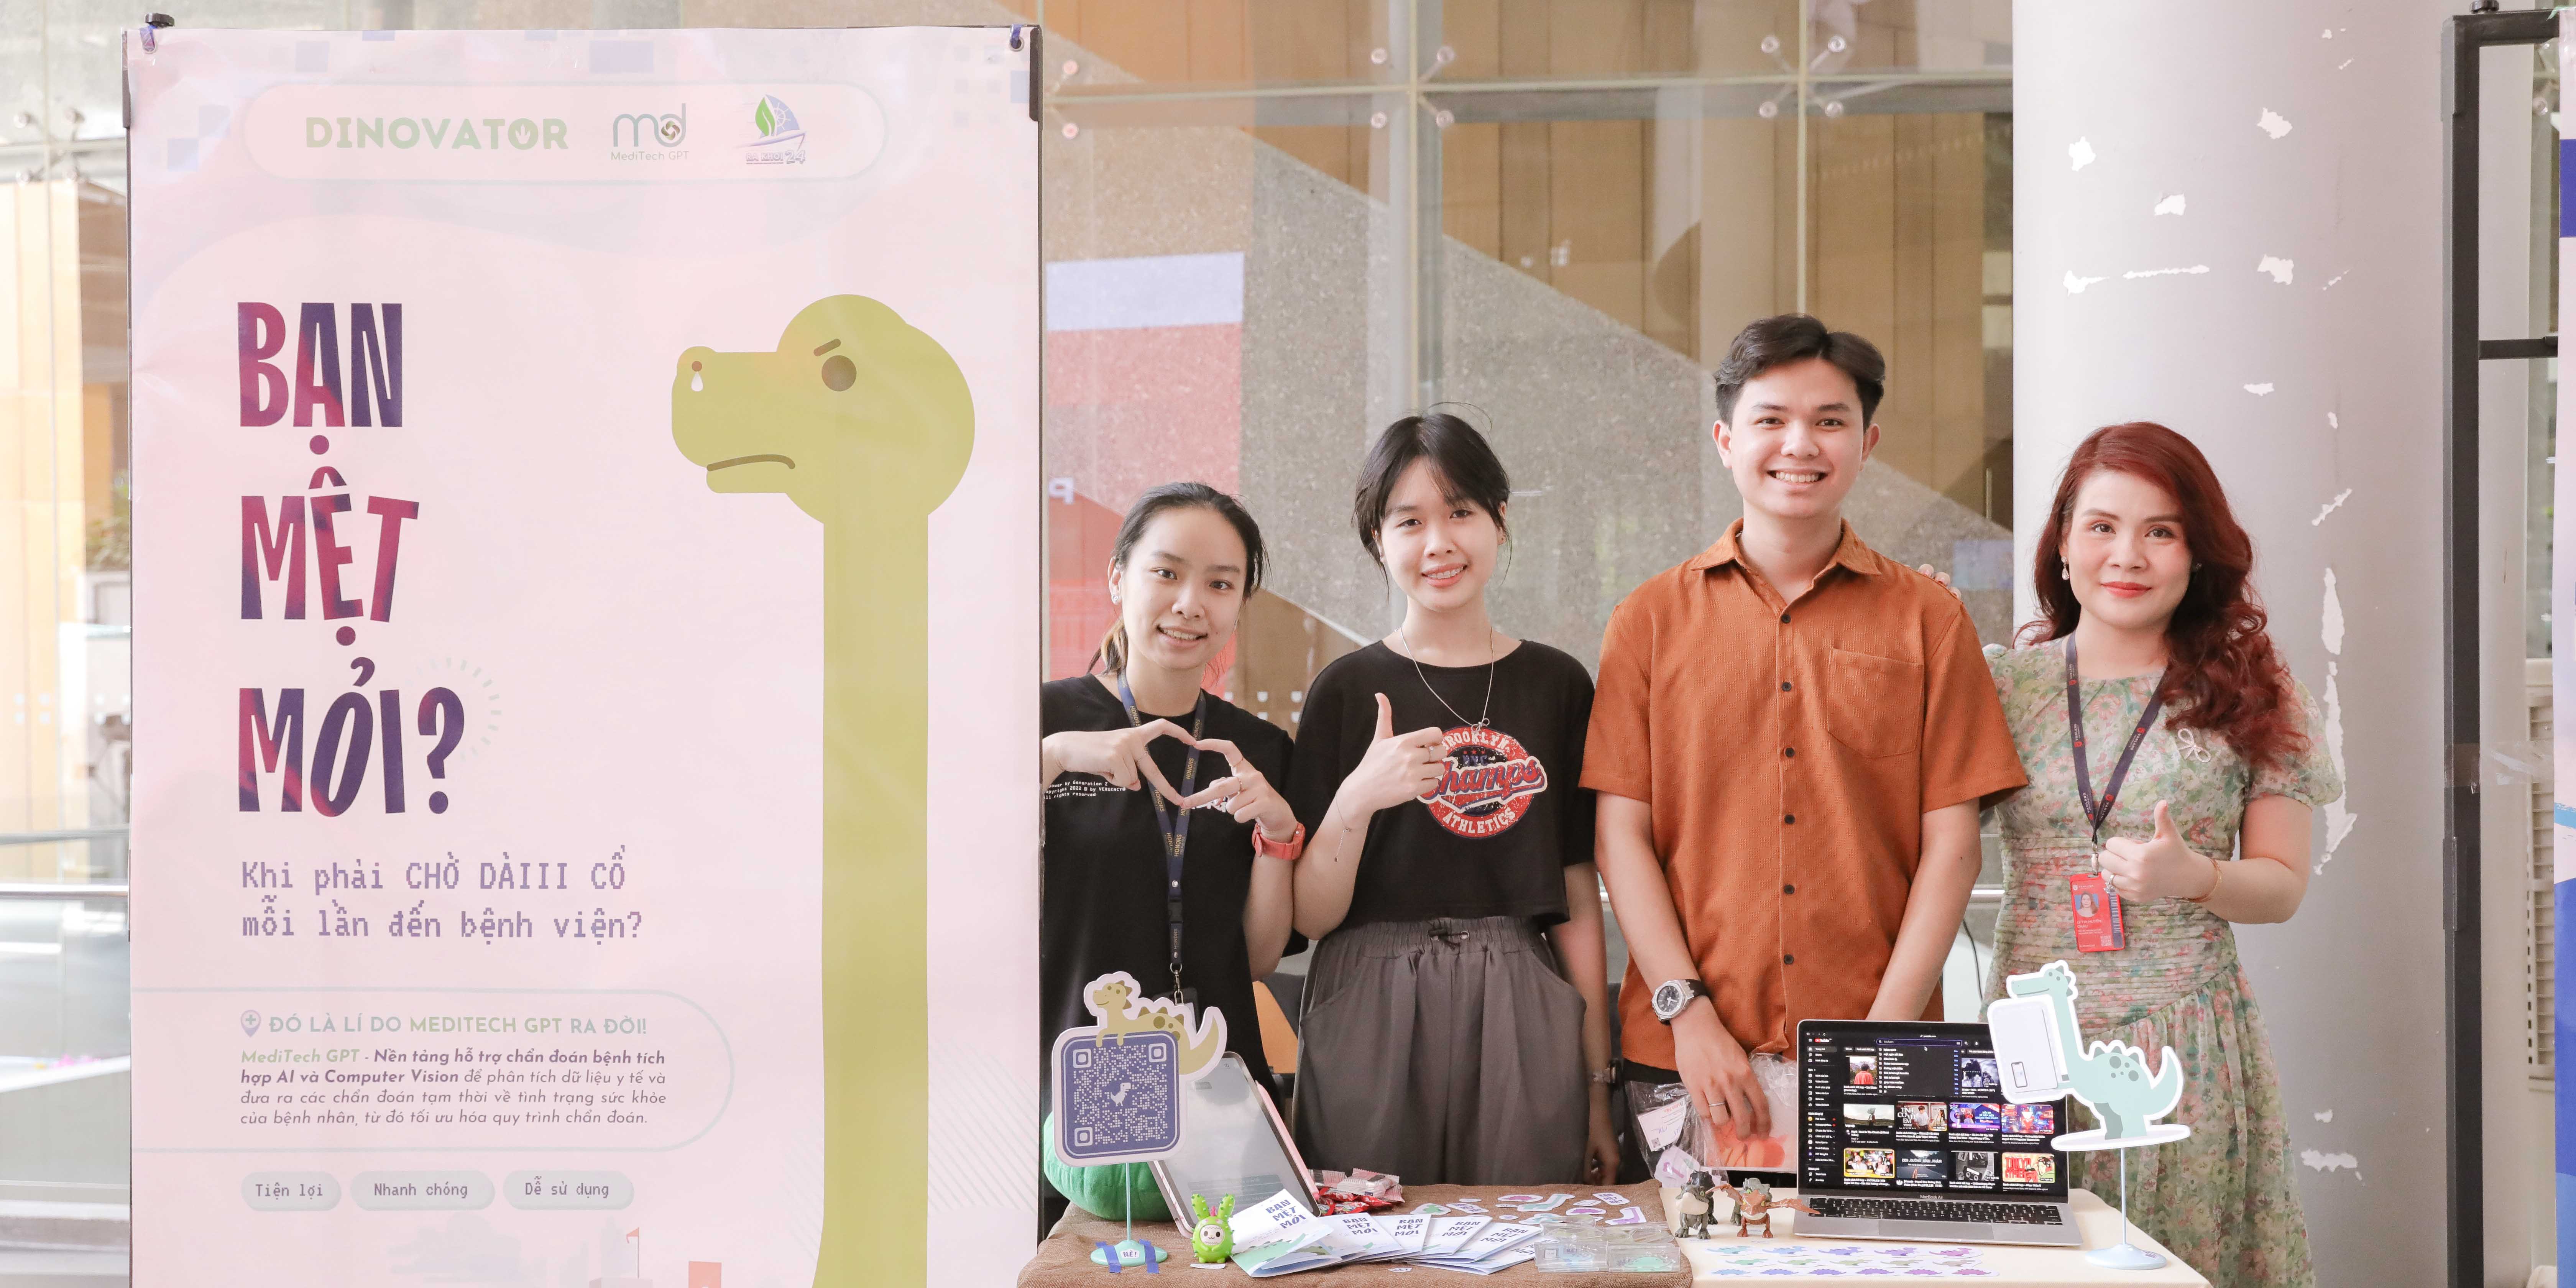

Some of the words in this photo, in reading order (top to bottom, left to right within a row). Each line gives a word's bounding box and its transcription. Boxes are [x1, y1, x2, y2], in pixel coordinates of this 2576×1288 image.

[306, 117, 568, 150] DINOVATOR
[611, 151, 665, 161] MediTech
[668, 150, 690, 160] GPT
[237, 302, 402, 455] BẠN
[241, 466, 419, 646] MỆT
[1130, 705, 1141, 727] HONORS
[238, 657, 465, 817] MỎI?
[1186, 757, 1194, 780] HONORS
[1154, 789, 1165, 812] HONORS
[1442, 807, 1516, 834] ATHLETICS
[1174, 834, 1182, 857] HONORS
[242, 861, 293, 888] Khi
[314, 858, 383, 896] phải
[406, 851, 459, 889] CHỜ
[480, 851, 567, 889] DÀIII
[591, 844, 625, 890] CỔ
[243, 895, 294, 936] mỗi
[319, 899, 368, 936] lần
[389, 899, 440, 937] đến
[461, 907, 532, 945] bệnh
[553, 907, 642, 945] viện?
[268, 1013, 302, 1033] ĐÓ
[310, 1012, 336, 1032] LÀ
[344, 1012, 362, 1032] LÍ
[371, 1016, 401, 1032] DO
[410, 1016, 516, 1033] MEDITECH
[524, 1017, 562, 1033] GPT
[570, 1018, 597, 1034] RA
[603, 1015, 646, 1035] ĐỜI!
[241, 1048, 320, 1063] MediTech
[326, 1048, 360, 1063] GPT
[374, 1048, 407, 1062] Nền
[412, 1049, 449, 1066] tảng
[454, 1047, 473, 1062] hỗ
[478, 1051, 502, 1065] trợ
[506, 1048, 544, 1063] chẩn
[549, 1049, 588, 1063] đoán
[593, 1049, 631, 1066] bệnh
[636, 1050, 665, 1064] tích
[241, 1069, 272, 1087] hợp
[276, 1070, 294, 1083] AI
[300, 1071, 319, 1083] và
[325, 1069, 405, 1086] Computer
[411, 1069, 458, 1083] Vision
[464, 1068, 482, 1083] để
[487, 1068, 524, 1086] phân
[530, 1069, 556, 1083] tích
[562, 1069, 582, 1083] dữ
[586, 1069, 611, 1086] liệu
[617, 1075, 625, 1086] y
[629, 1070, 644, 1084] tế
[649, 1072, 665, 1084] và
[240, 1089, 269, 1104] đưa
[277, 1095, 292, 1104] ra
[300, 1091, 326, 1103] các
[333, 1089, 369, 1103] chẩn
[377, 1089, 414, 1103] đoán
[422, 1091, 451, 1105] tạm
[458, 1089, 487, 1102] thời
[495, 1089, 511, 1102] về
[518, 1089, 546, 1102] tình
[554, 1092, 594, 1106] trạng
[601, 1091, 625, 1103] sức
[632, 1089, 666, 1104] khỏe
[240, 1111, 267, 1124] của
[273, 1109, 310, 1126] bệnh
[317, 1109, 358, 1126] nhân,
[365, 1111, 381, 1123] từ
[386, 1109, 404, 1123] đó
[410, 1109, 429, 1123] tối
[435, 1115, 453, 1123] ưu
[459, 1109, 487, 1123] hóa
[493, 1114, 520, 1126] quy
[526, 1109, 560, 1123] trình
[565, 1109, 601, 1123] chẩn
[607, 1109, 647, 1123] đoán.
[255, 1182, 289, 1200] Tiện
[299, 1183, 323, 1200] lợi
[374, 1183, 416, 1196] Nhanh
[426, 1181, 468, 1199] chóng
[525, 1176, 542, 1195] Dễ
[551, 1181, 568, 1195] sử
[576, 1183, 609, 1199] dụng
